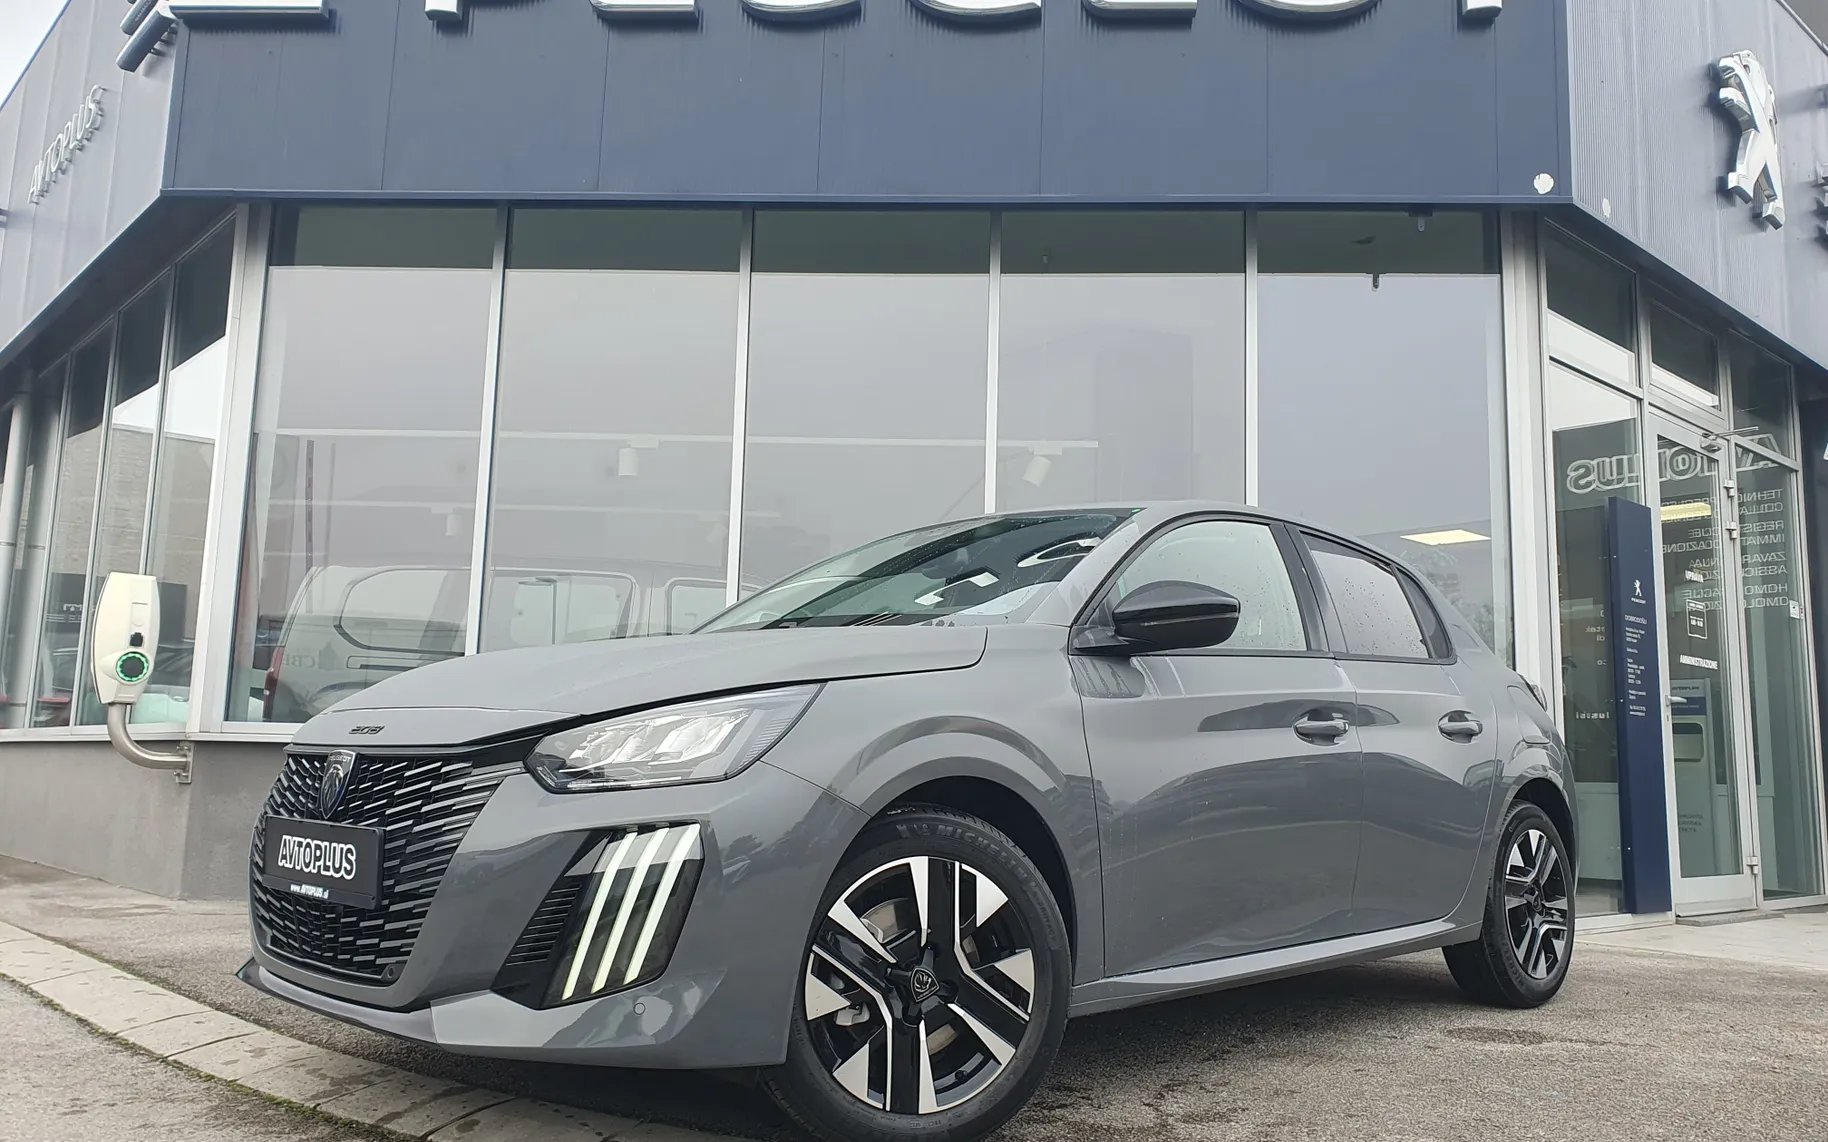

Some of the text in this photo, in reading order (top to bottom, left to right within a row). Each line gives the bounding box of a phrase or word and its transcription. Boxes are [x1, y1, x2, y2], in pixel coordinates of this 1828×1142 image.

[28, 85, 107, 204] AVTOPLUS
[348, 725, 385, 735] 208
[278, 834, 356, 880] AVTOPLUS
[936, 824, 1029, 882] MICHELIN
